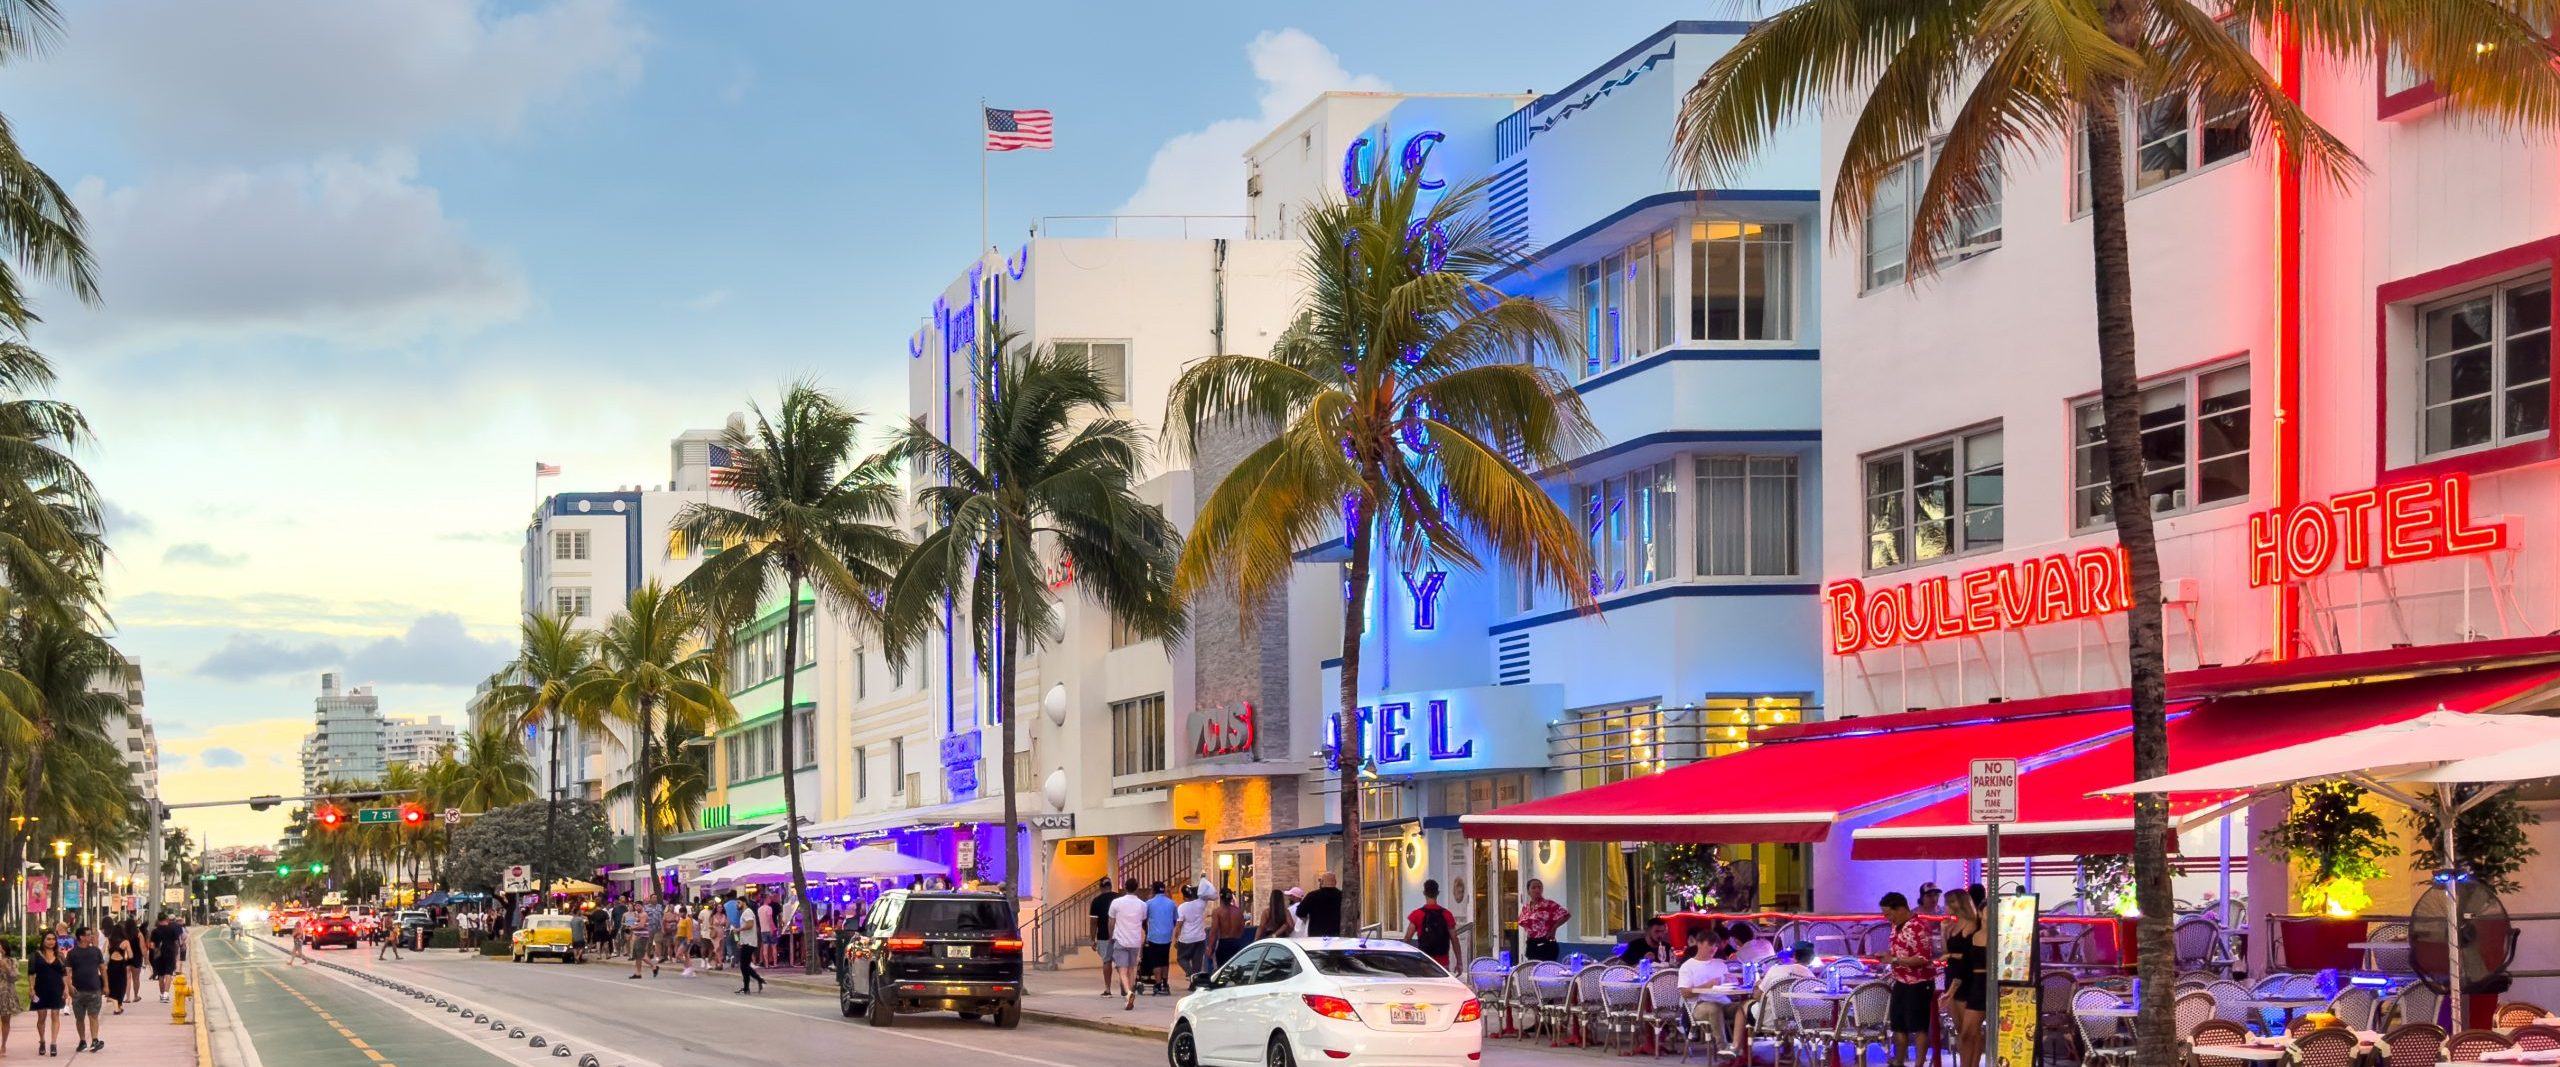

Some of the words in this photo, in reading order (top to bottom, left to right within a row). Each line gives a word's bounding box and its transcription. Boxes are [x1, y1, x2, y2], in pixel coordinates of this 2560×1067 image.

[2250, 472, 2507, 588] HOTEL
[1984, 762, 2002, 773] NO
[1974, 775, 2013, 787] PARKING
[1985, 789, 2001, 797] ANY
[1984, 799, 2001, 807] TIME
[372, 811, 378, 820] 7
[382, 811, 392, 819] ST
[1044, 816, 1071, 828] CVS
